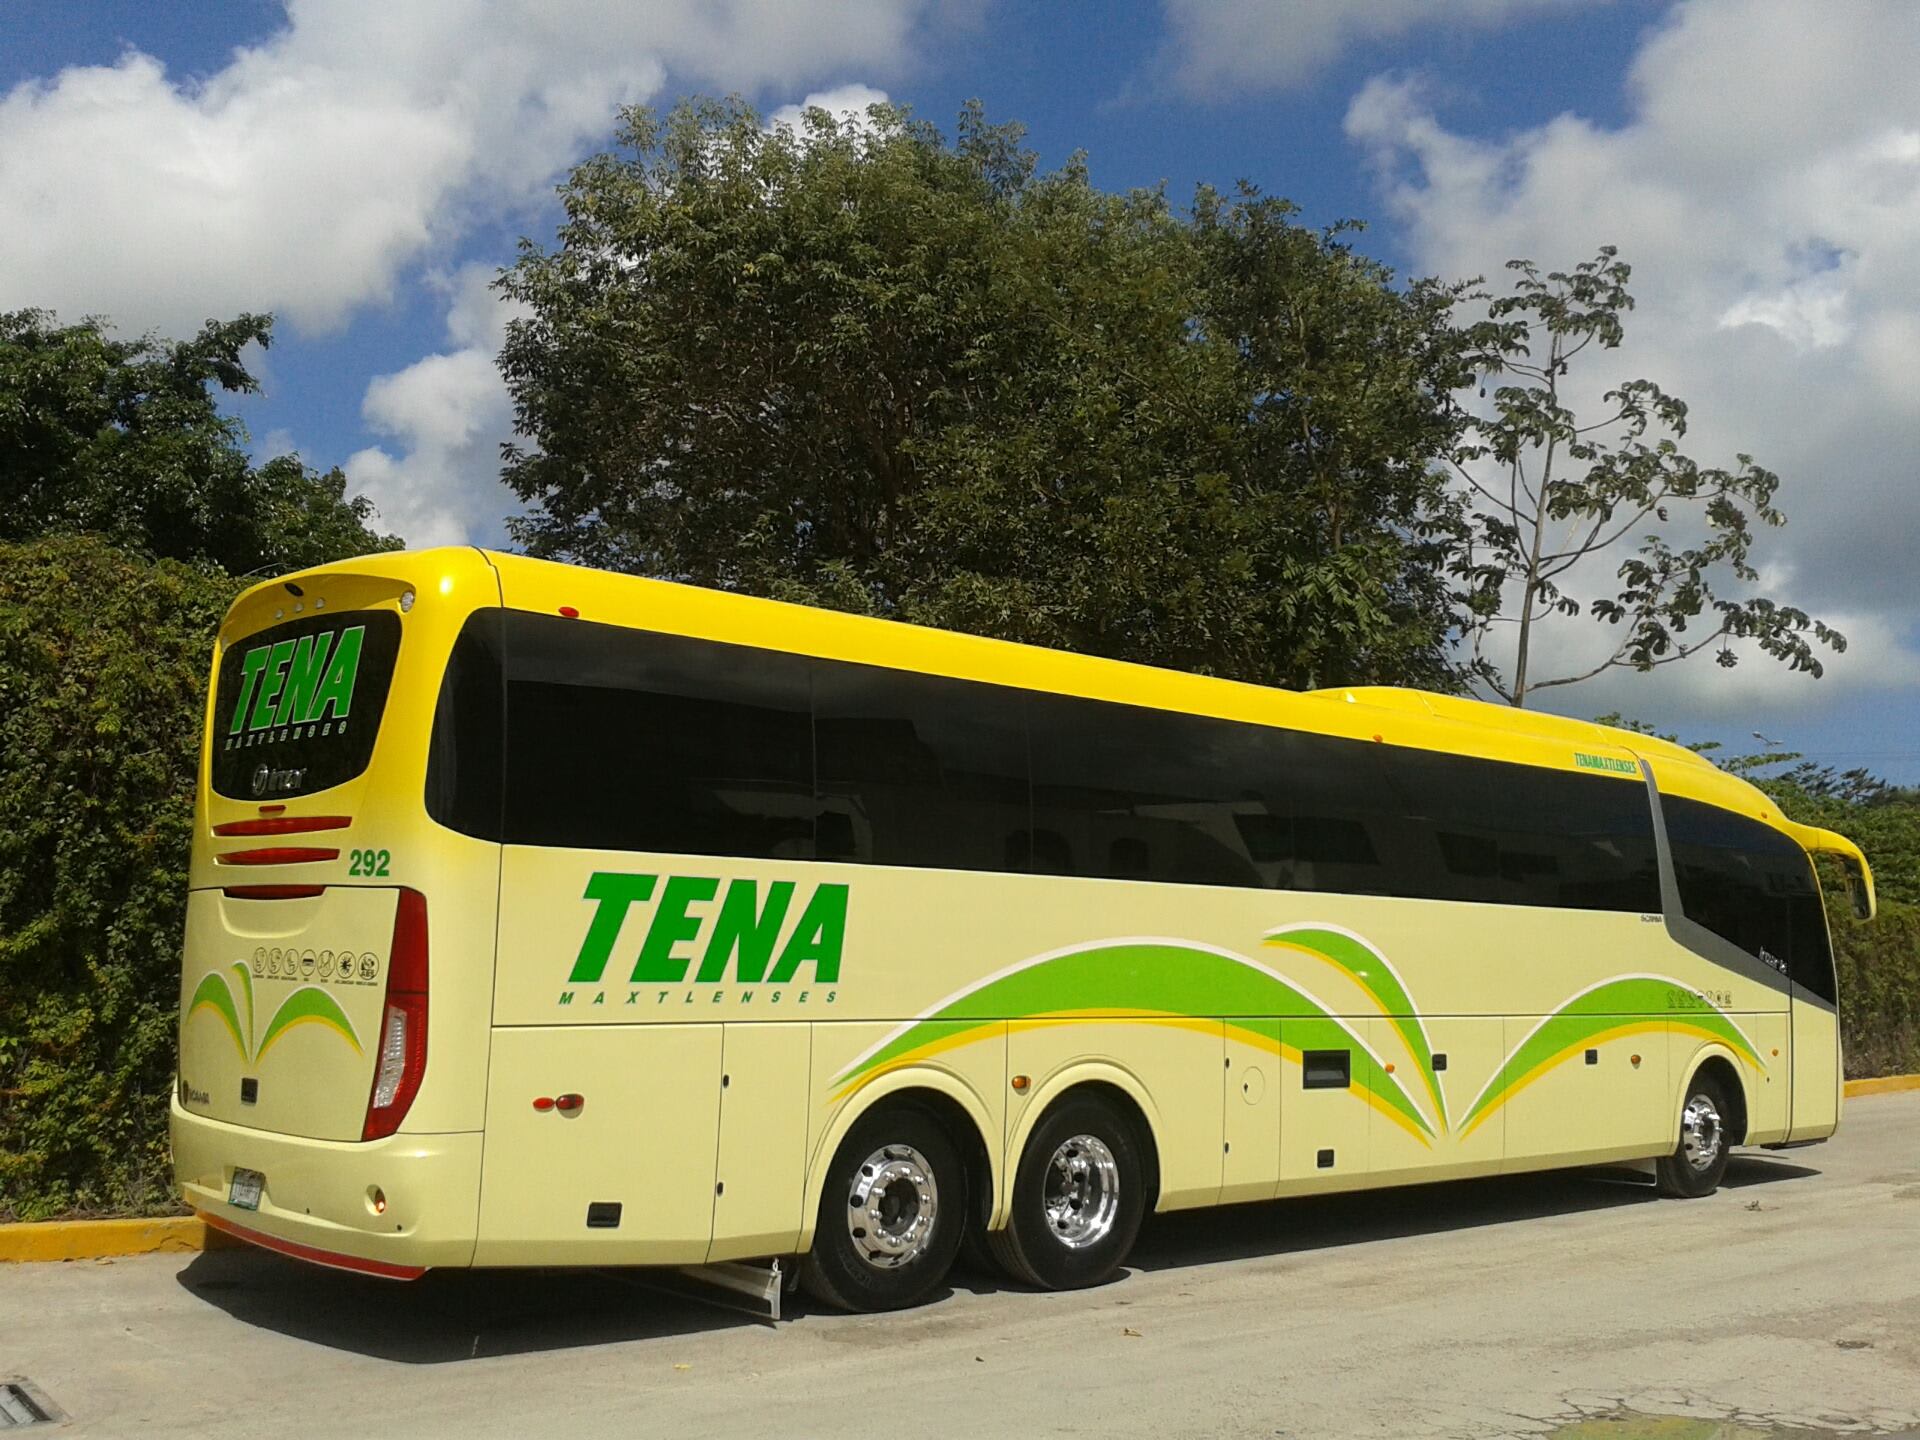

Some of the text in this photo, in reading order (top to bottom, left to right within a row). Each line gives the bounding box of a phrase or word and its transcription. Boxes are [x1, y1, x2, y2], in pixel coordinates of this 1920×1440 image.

[229, 625, 365, 736] TENA
[224, 720, 348, 751] MAXTLENSES
[349, 849, 390, 876] 292
[567, 871, 850, 983] TENA
[558, 990, 836, 1005] MAXTLENSES
